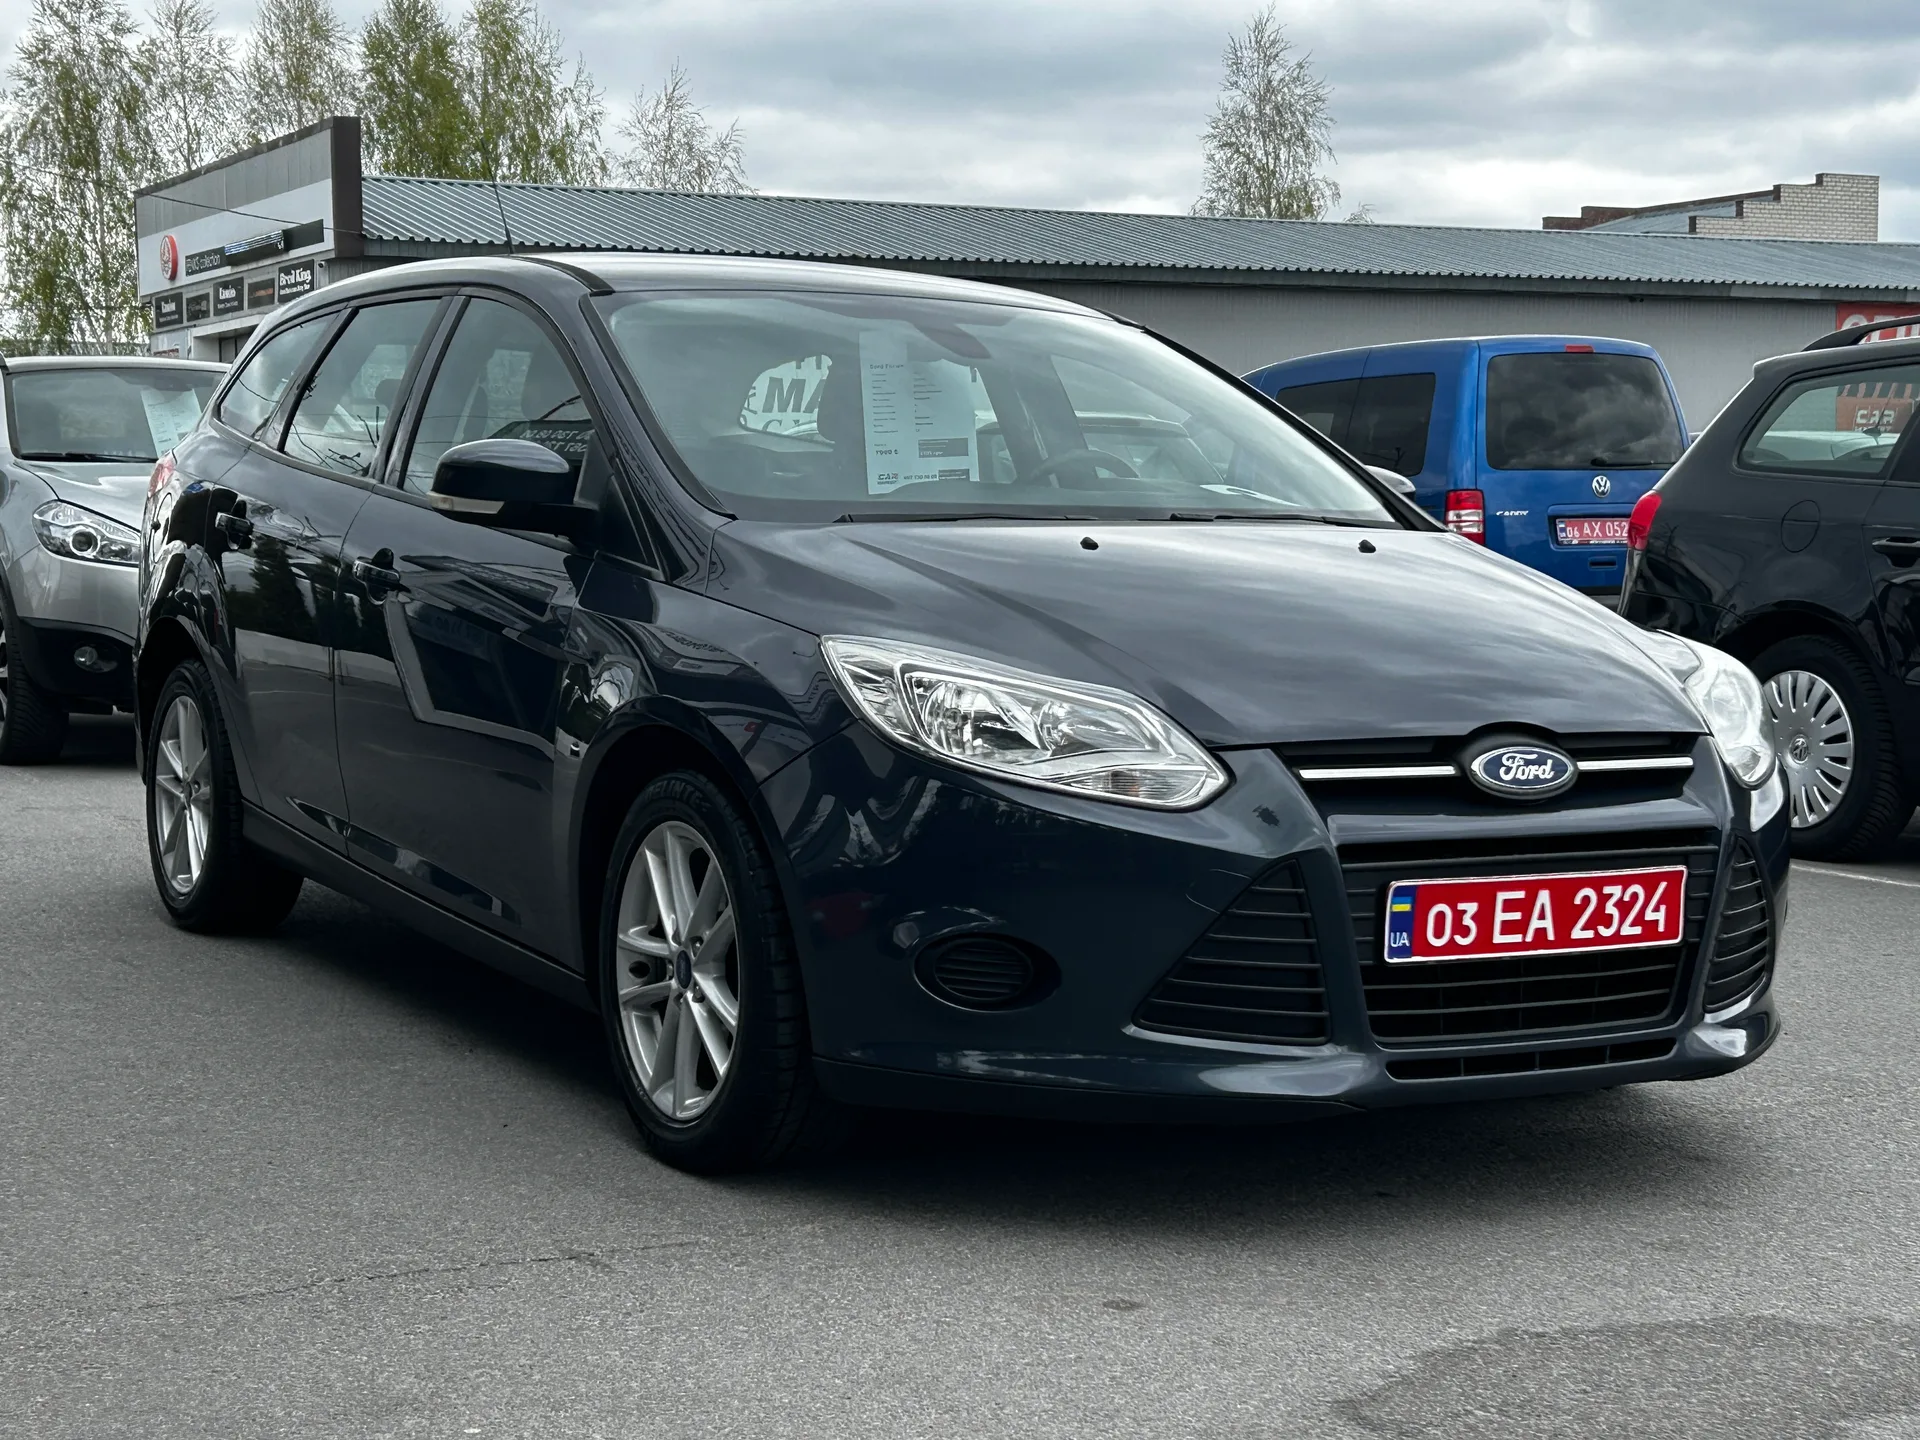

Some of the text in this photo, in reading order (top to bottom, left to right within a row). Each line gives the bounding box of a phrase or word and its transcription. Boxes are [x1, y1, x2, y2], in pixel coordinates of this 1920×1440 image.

[1566, 521, 1628, 538] 06 AX 052
[1499, 752, 1555, 780] Ford
[1426, 881, 1668, 947] 03 EA 2324
[1390, 931, 1410, 948] UA
